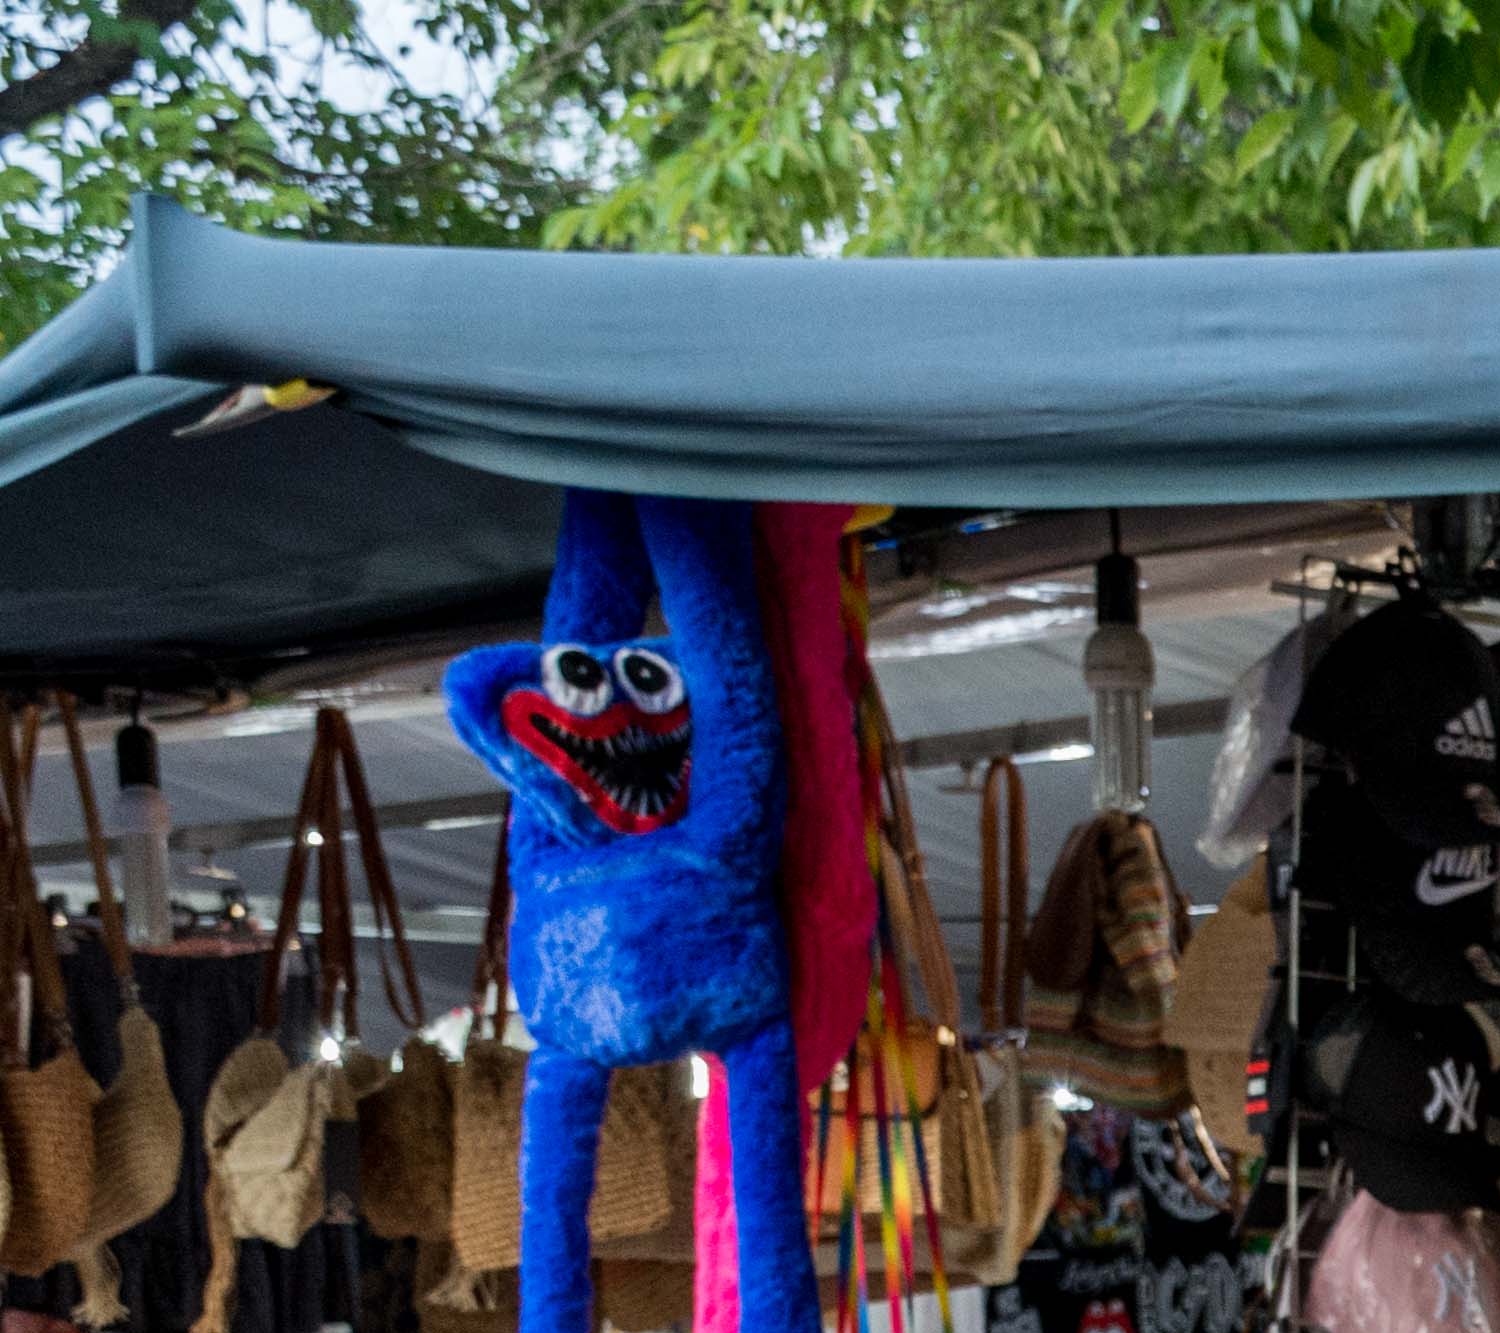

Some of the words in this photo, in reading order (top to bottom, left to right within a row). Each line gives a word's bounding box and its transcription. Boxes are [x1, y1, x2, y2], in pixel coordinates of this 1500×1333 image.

[1434, 734, 1496, 761] adidas
[1430, 845, 1496, 879] NIKE
[1422, 1056, 1481, 1134] NY
